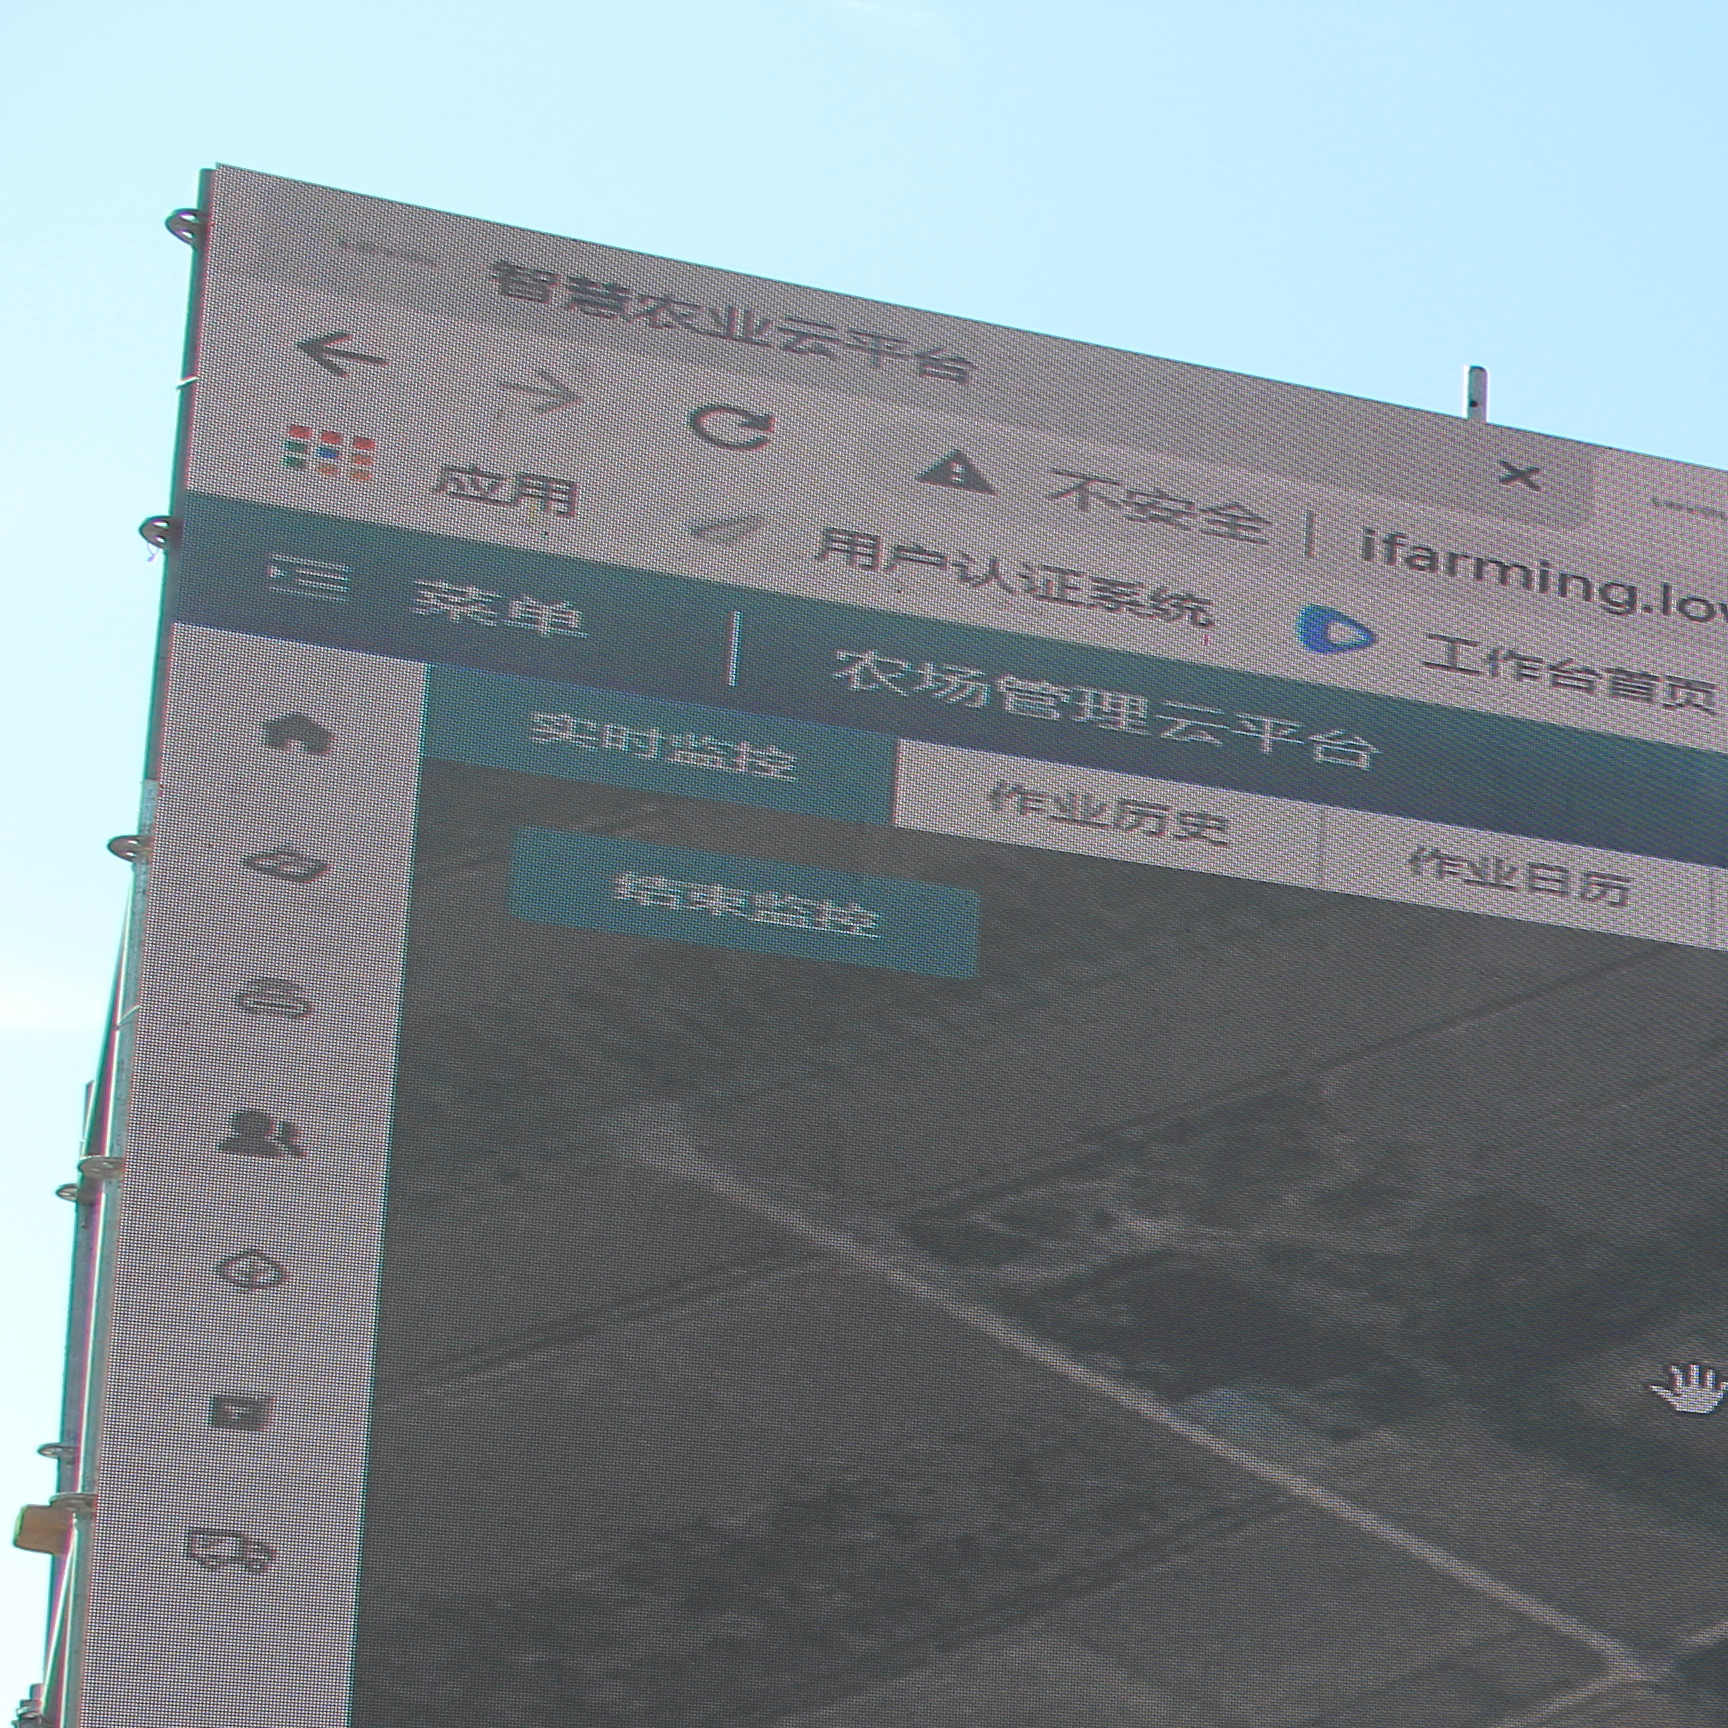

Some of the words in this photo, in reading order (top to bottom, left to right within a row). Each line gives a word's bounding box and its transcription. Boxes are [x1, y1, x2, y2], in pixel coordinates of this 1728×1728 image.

[491, 259, 976, 386] 智慧农业云平台
[433, 464, 578, 520] 应用
[1047, 468, 1274, 545] 不安全
[410, 577, 588, 639] 菜单
[815, 527, 1216, 630] 用户认证系统
[833, 647, 1382, 772] 农场管理云平台
[1423, 634, 1719, 717] 工作台首页
[530, 709, 800, 783] 实时监控
[987, 779, 1230, 848] 作业历史
[612, 869, 882, 939] 结束监控
[1409, 844, 1630, 909] 作业日历
